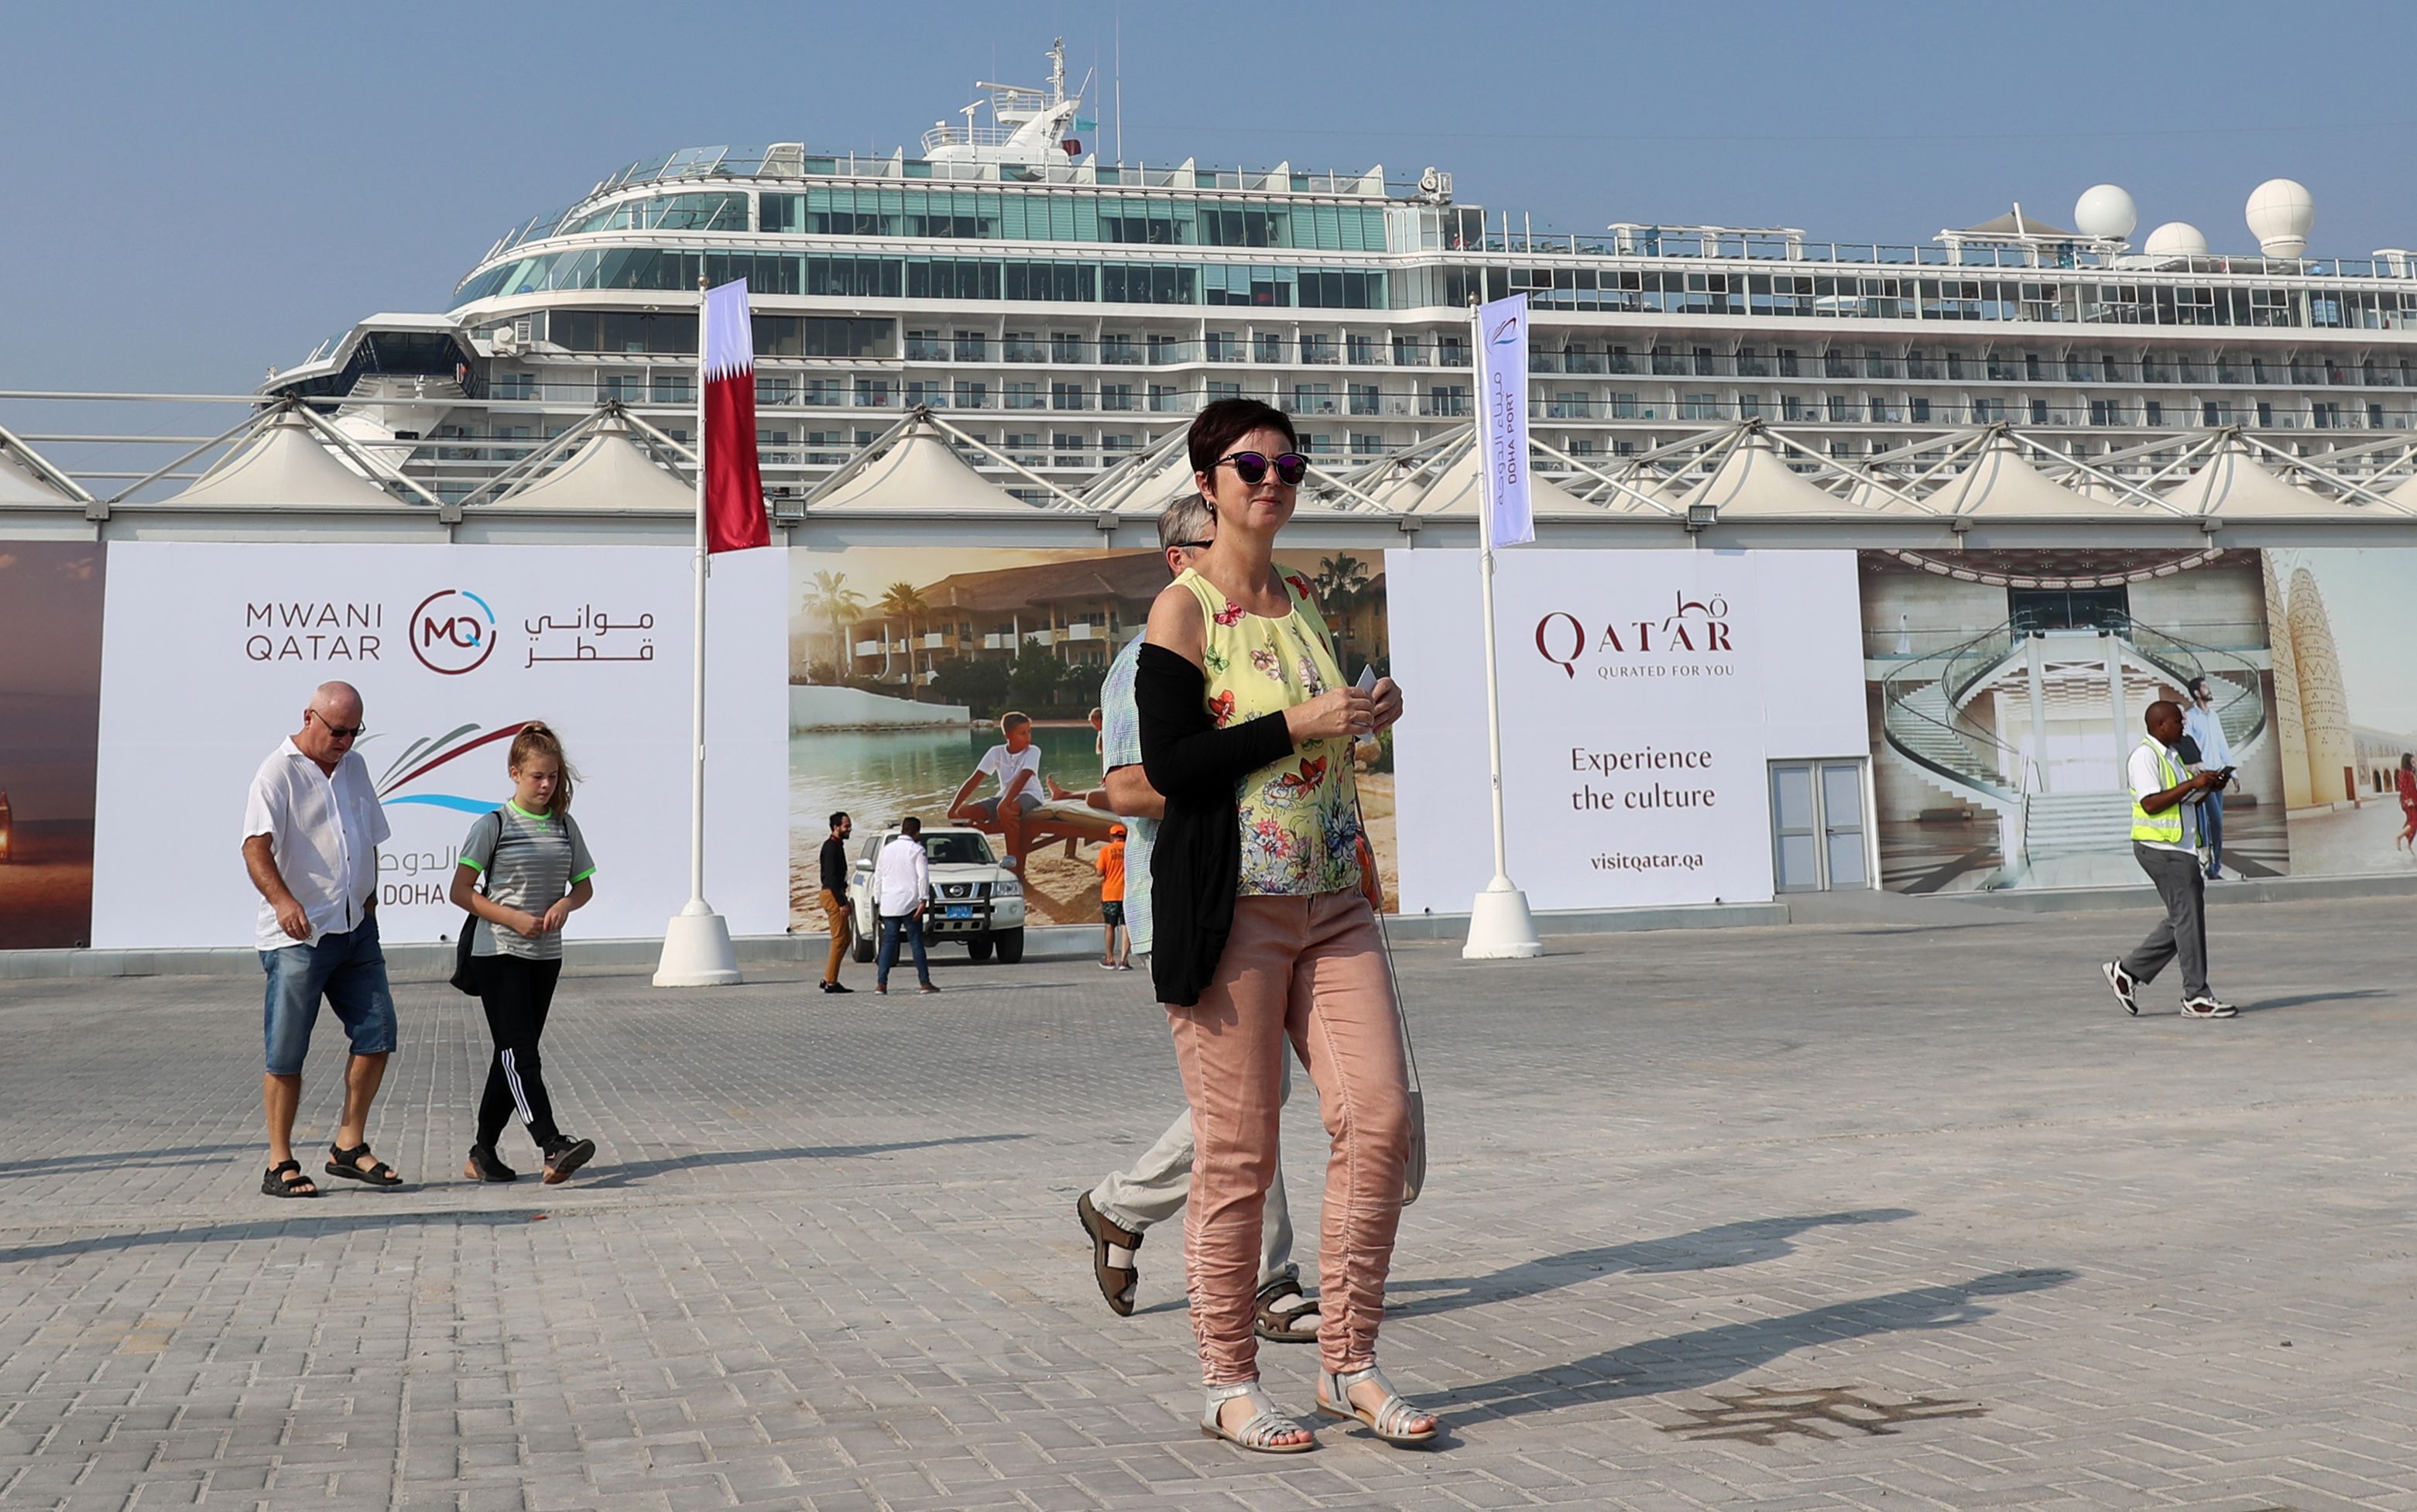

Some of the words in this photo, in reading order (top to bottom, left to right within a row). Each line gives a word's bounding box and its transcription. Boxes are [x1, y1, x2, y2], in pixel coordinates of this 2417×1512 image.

[1506, 392, 1514, 434] PORT
[1494, 436, 1506, 506] الدوحة
[1507, 438, 1517, 485] DOHA
[246, 603, 382, 629] MWANI
[525, 604, 654, 641] مواني
[246, 635, 381, 661] QATAR
[525, 636, 654, 669] قطر
[1598, 666, 1666, 680] QURATED
[1672, 665, 1700, 677] FOR
[1706, 664, 1734, 676] YOU
[1572, 746, 1712, 777] Experience
[1572, 784, 1614, 811] the
[1624, 783, 1716, 809] culture
[378, 845, 456, 876] الدوح
[384, 883, 445, 906] DOHA
